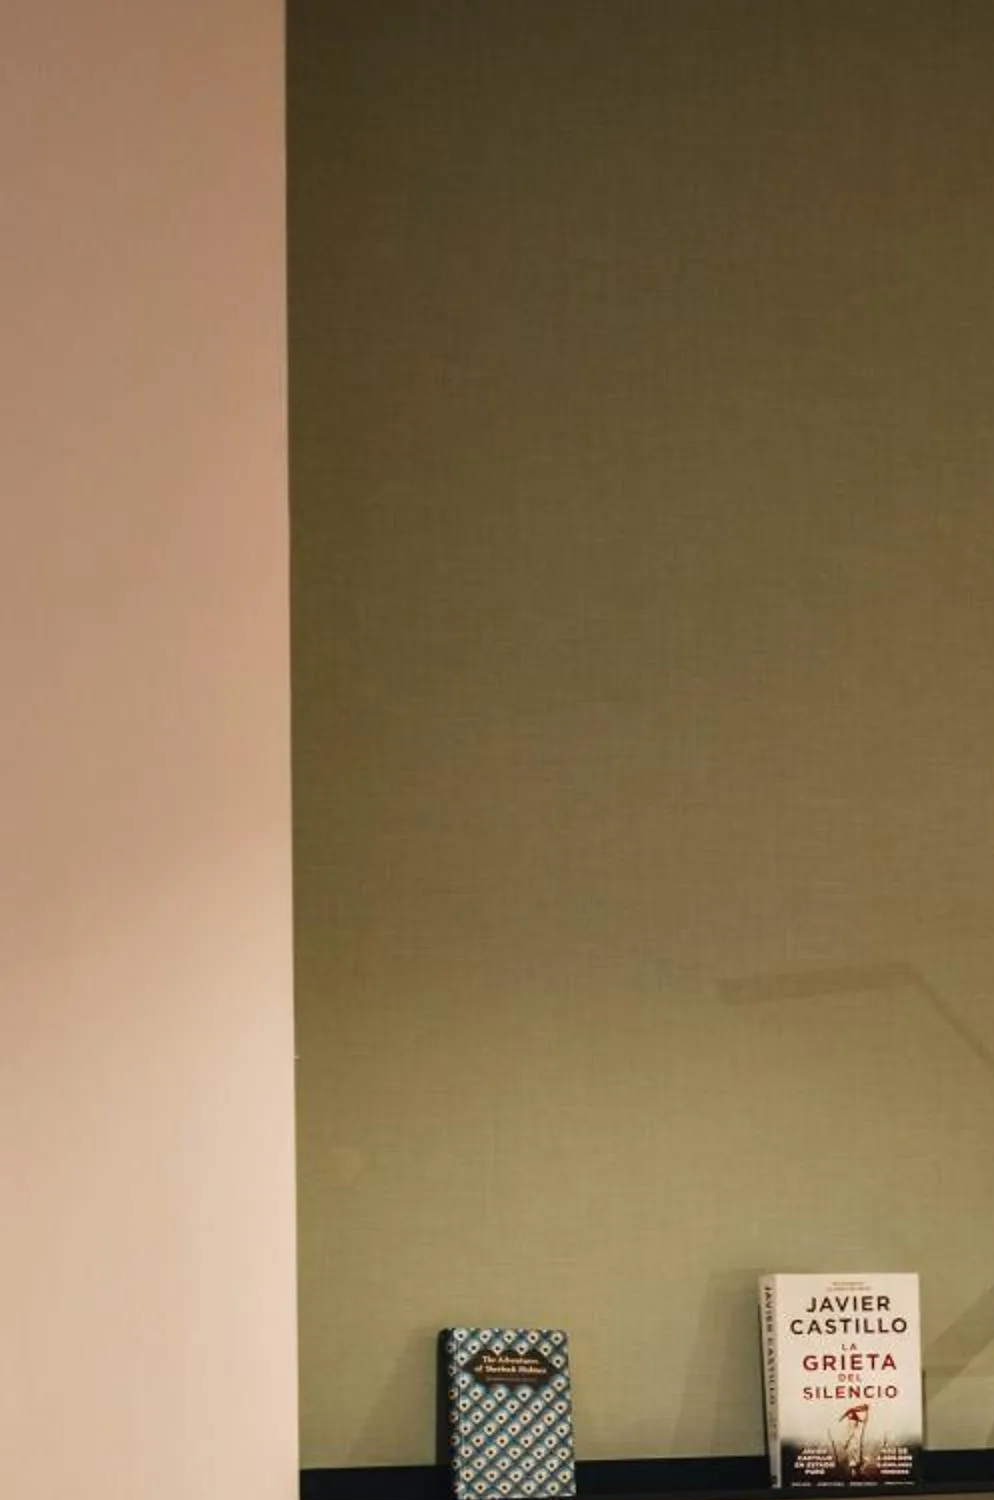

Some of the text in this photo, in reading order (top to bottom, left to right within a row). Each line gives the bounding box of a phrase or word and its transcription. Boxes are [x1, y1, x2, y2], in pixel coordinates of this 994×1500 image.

[763, 1285, 774, 1332] JAVIER
[806, 1295, 891, 1313] JAVIER
[789, 1317, 908, 1336] CASTILLO
[841, 1343, 858, 1351] LA
[802, 1353, 897, 1372] GRIETA
[837, 1373, 862, 1383] DEL
[802, 1385, 898, 1400] SILENCIO
